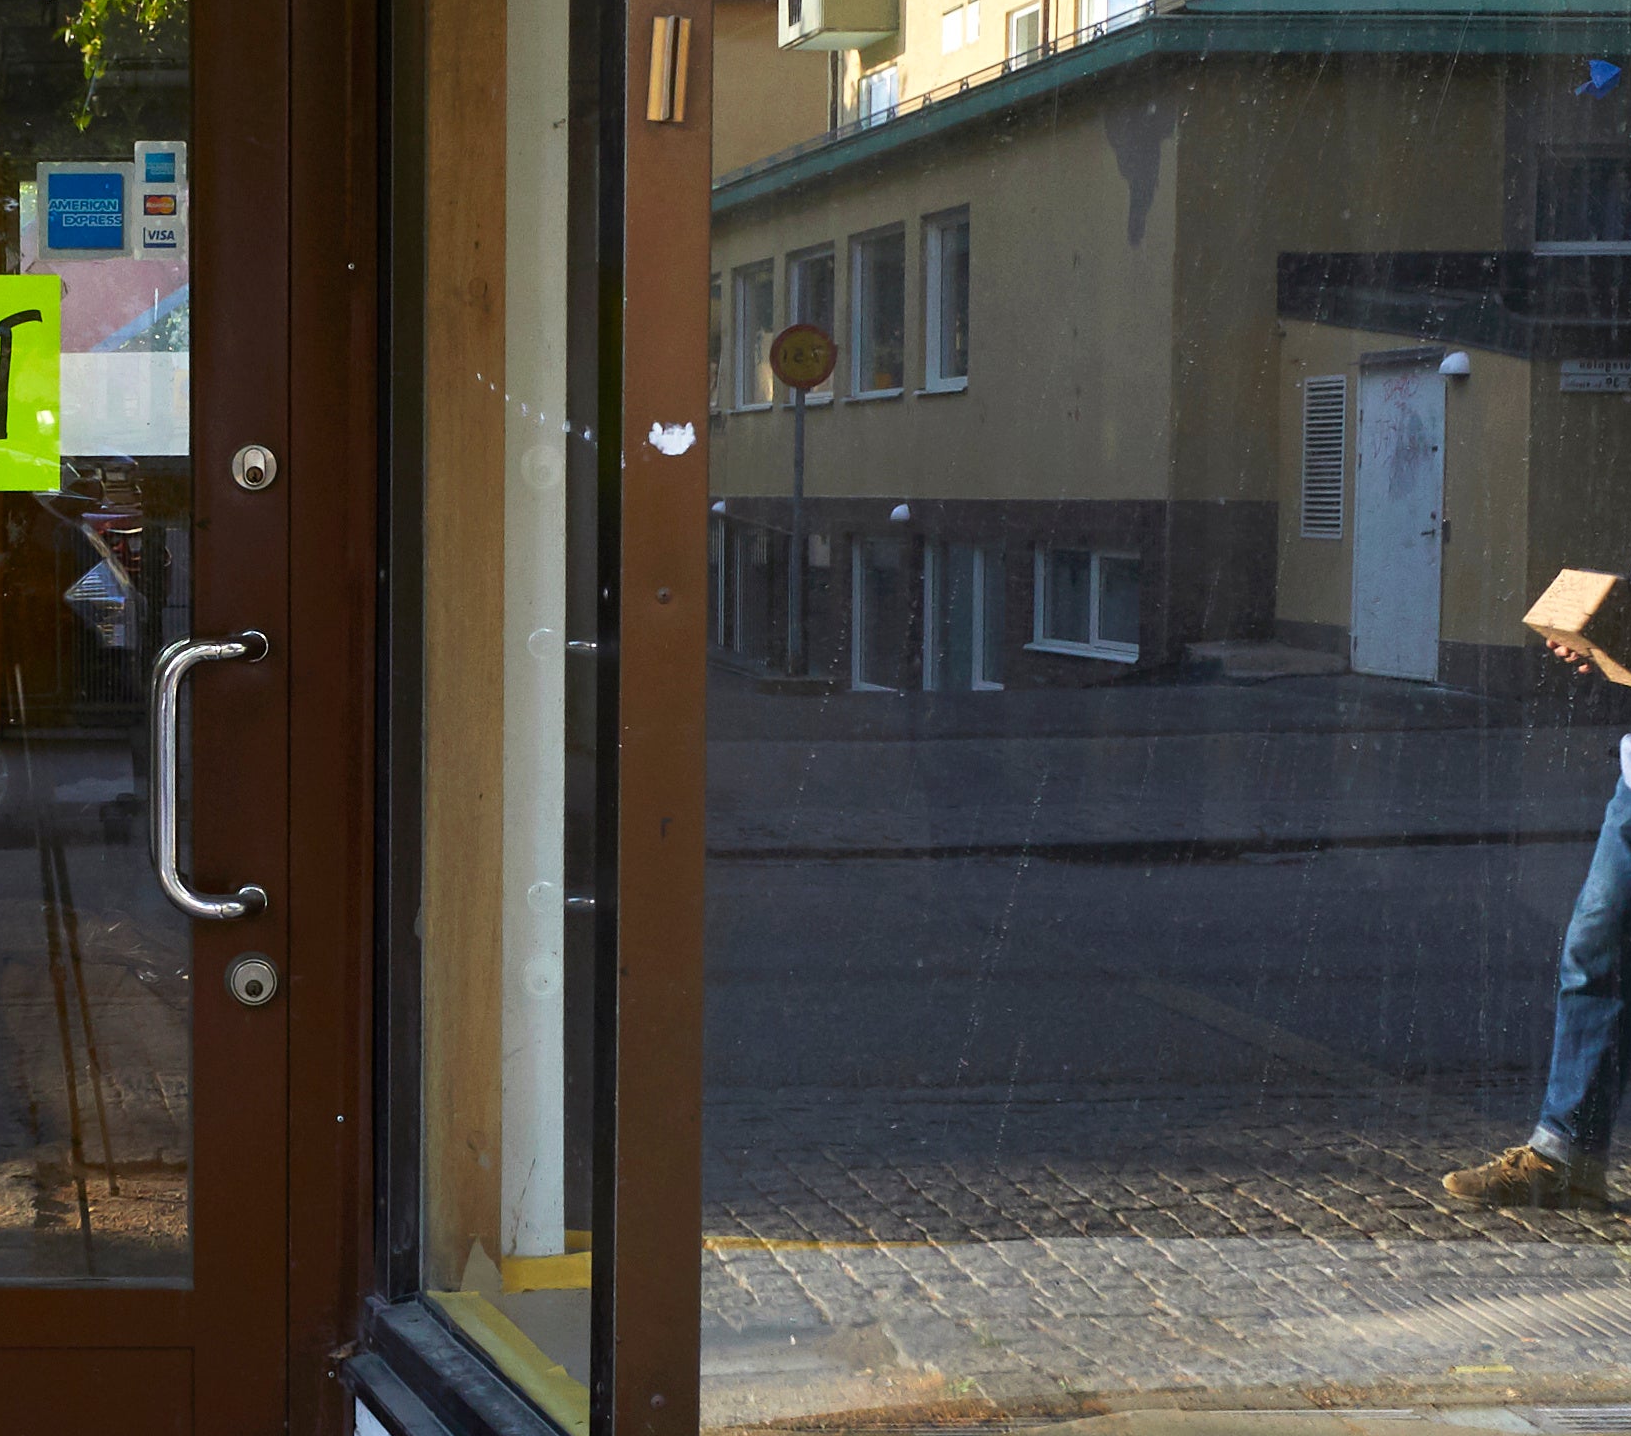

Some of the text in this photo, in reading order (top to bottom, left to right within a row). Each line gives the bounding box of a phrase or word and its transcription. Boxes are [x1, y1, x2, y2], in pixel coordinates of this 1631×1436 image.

[49, 199, 119, 212] AMERICAN
[63, 214, 122, 227] EXPRESS
[148, 230, 175, 240] VISA
